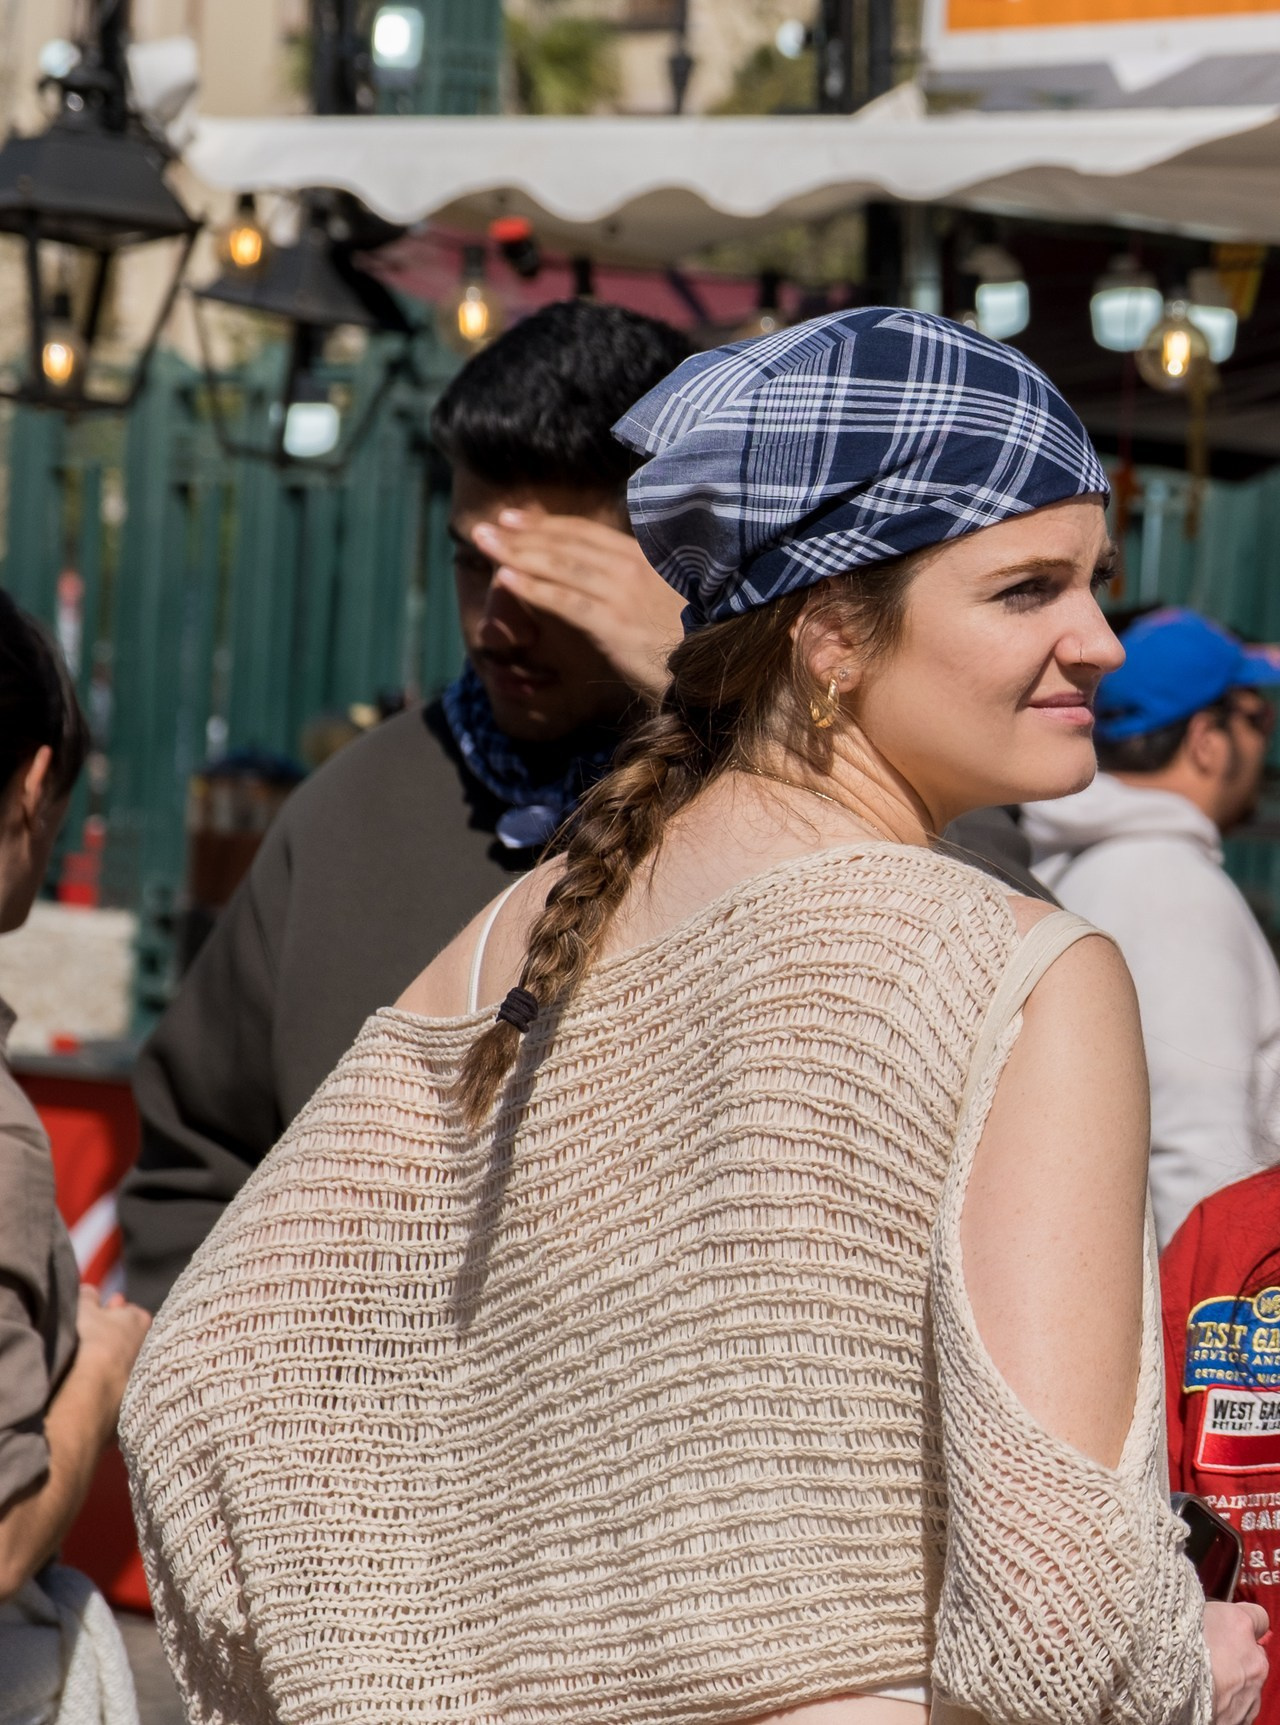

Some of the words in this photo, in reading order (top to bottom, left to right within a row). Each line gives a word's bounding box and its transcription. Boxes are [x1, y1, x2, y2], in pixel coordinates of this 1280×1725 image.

[1213, 1399, 1255, 1421] WEST
[1204, 1494, 1247, 1509] PAIR
[1249, 1550, 1267, 1568] &
